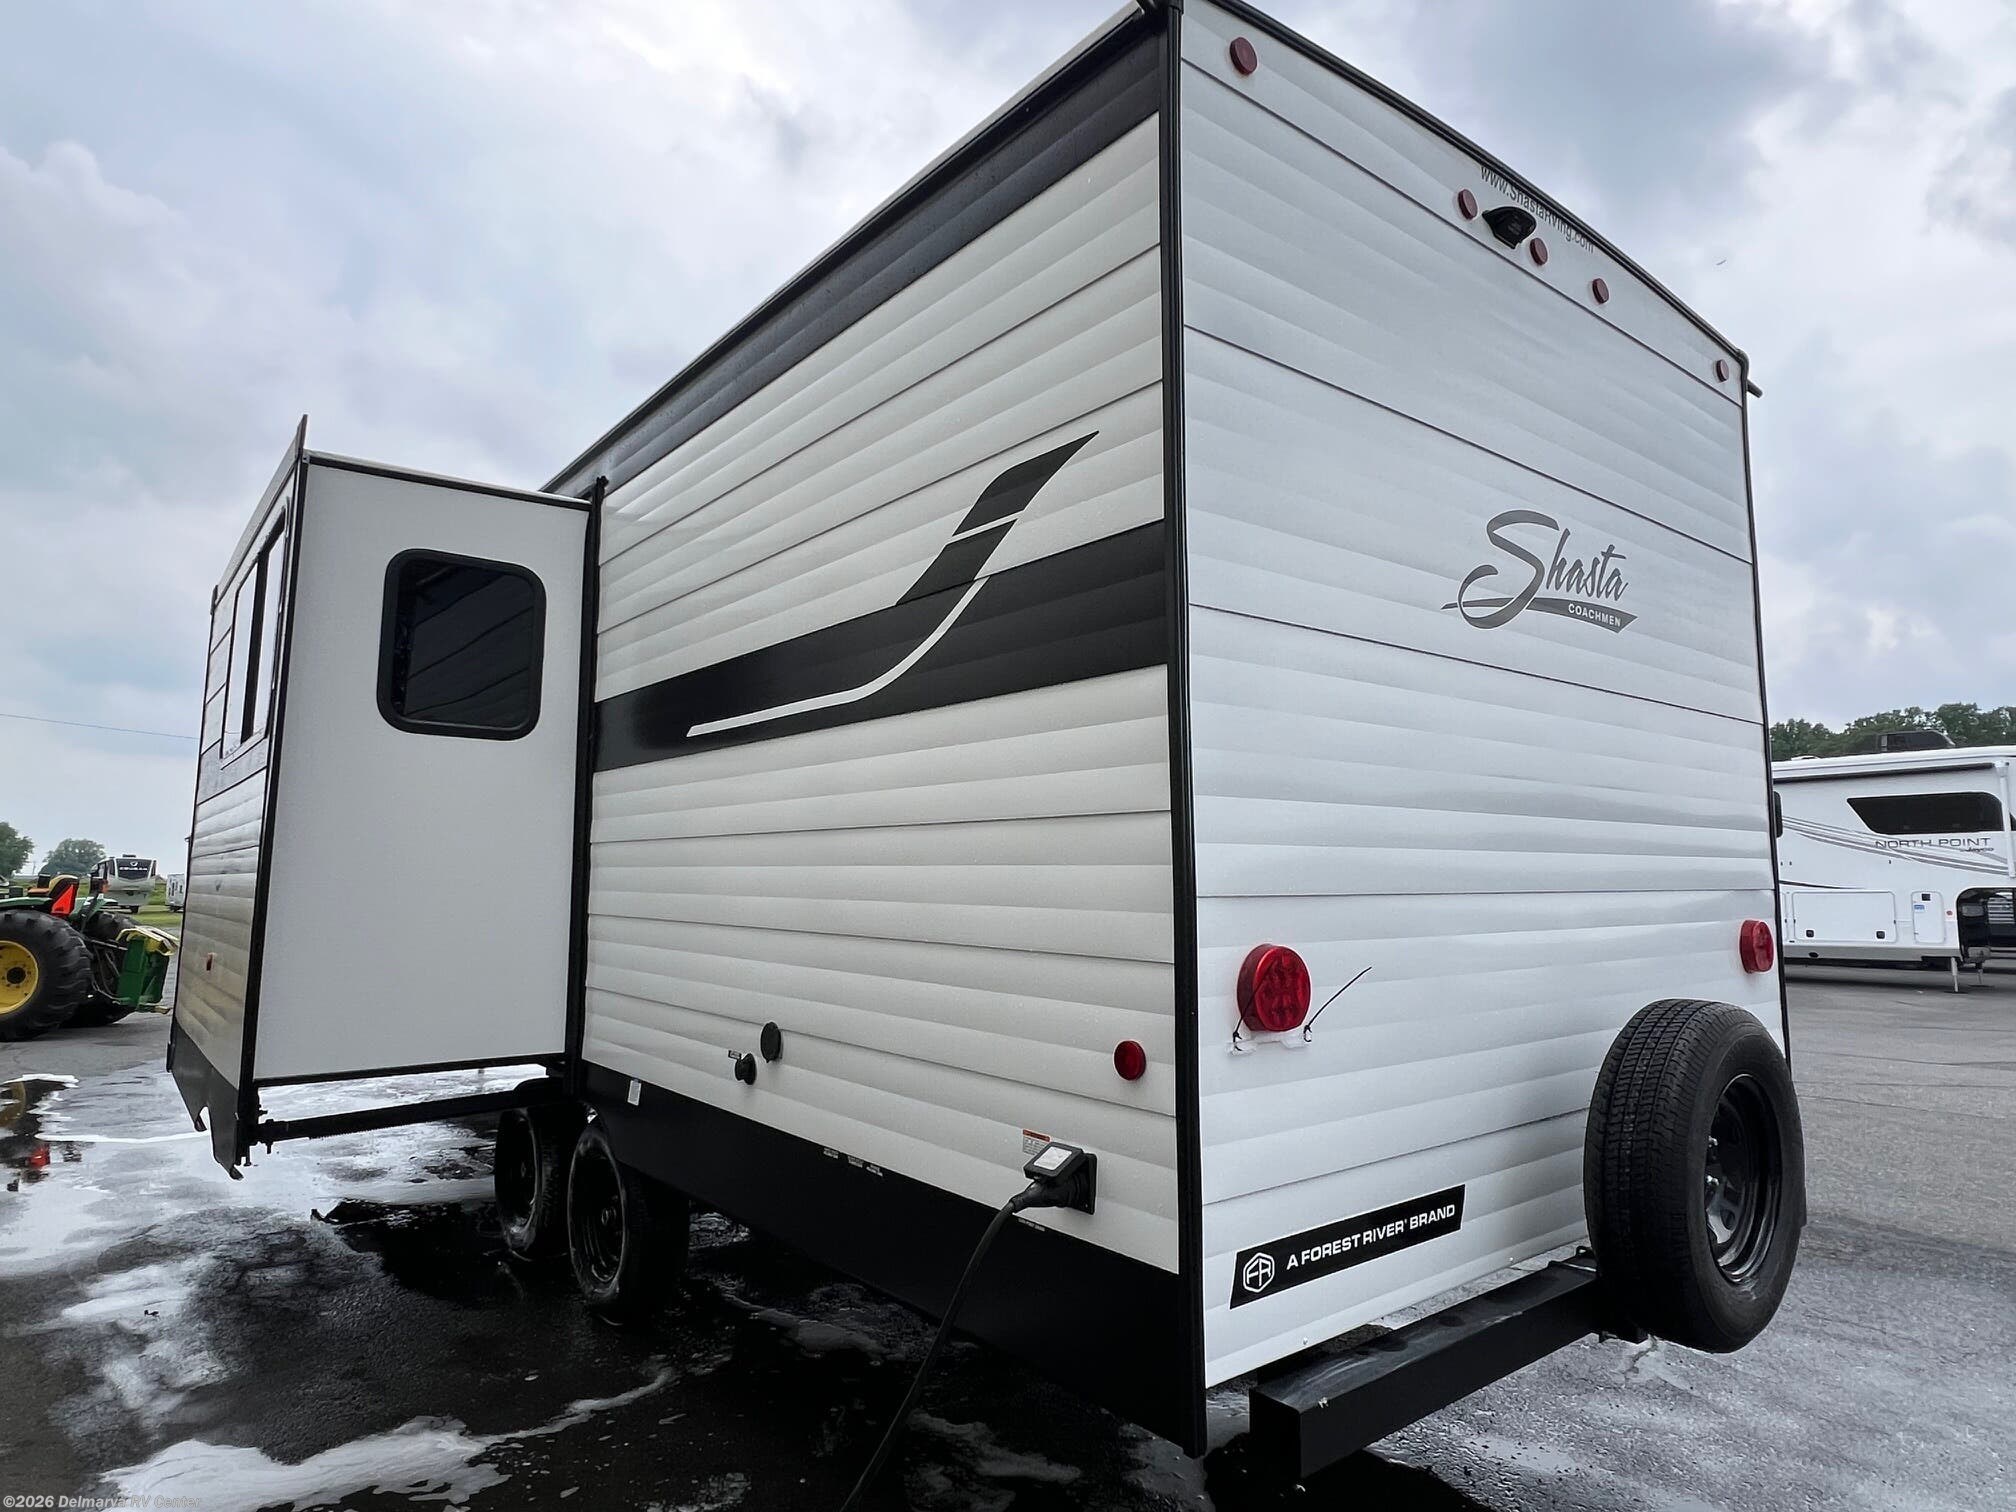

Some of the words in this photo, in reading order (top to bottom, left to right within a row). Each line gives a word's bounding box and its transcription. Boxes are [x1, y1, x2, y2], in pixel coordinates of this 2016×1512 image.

[1457, 509, 1629, 630] Shasta
[1567, 602, 1622, 628] COACHMEN
[1875, 839, 1932, 849] NORTH
[1938, 837, 1991, 848] POINT
[1286, 1254, 1299, 1271] A
[1300, 1233, 1362, 1266] FOREST
[1409, 1203, 1456, 1231] BRAND
